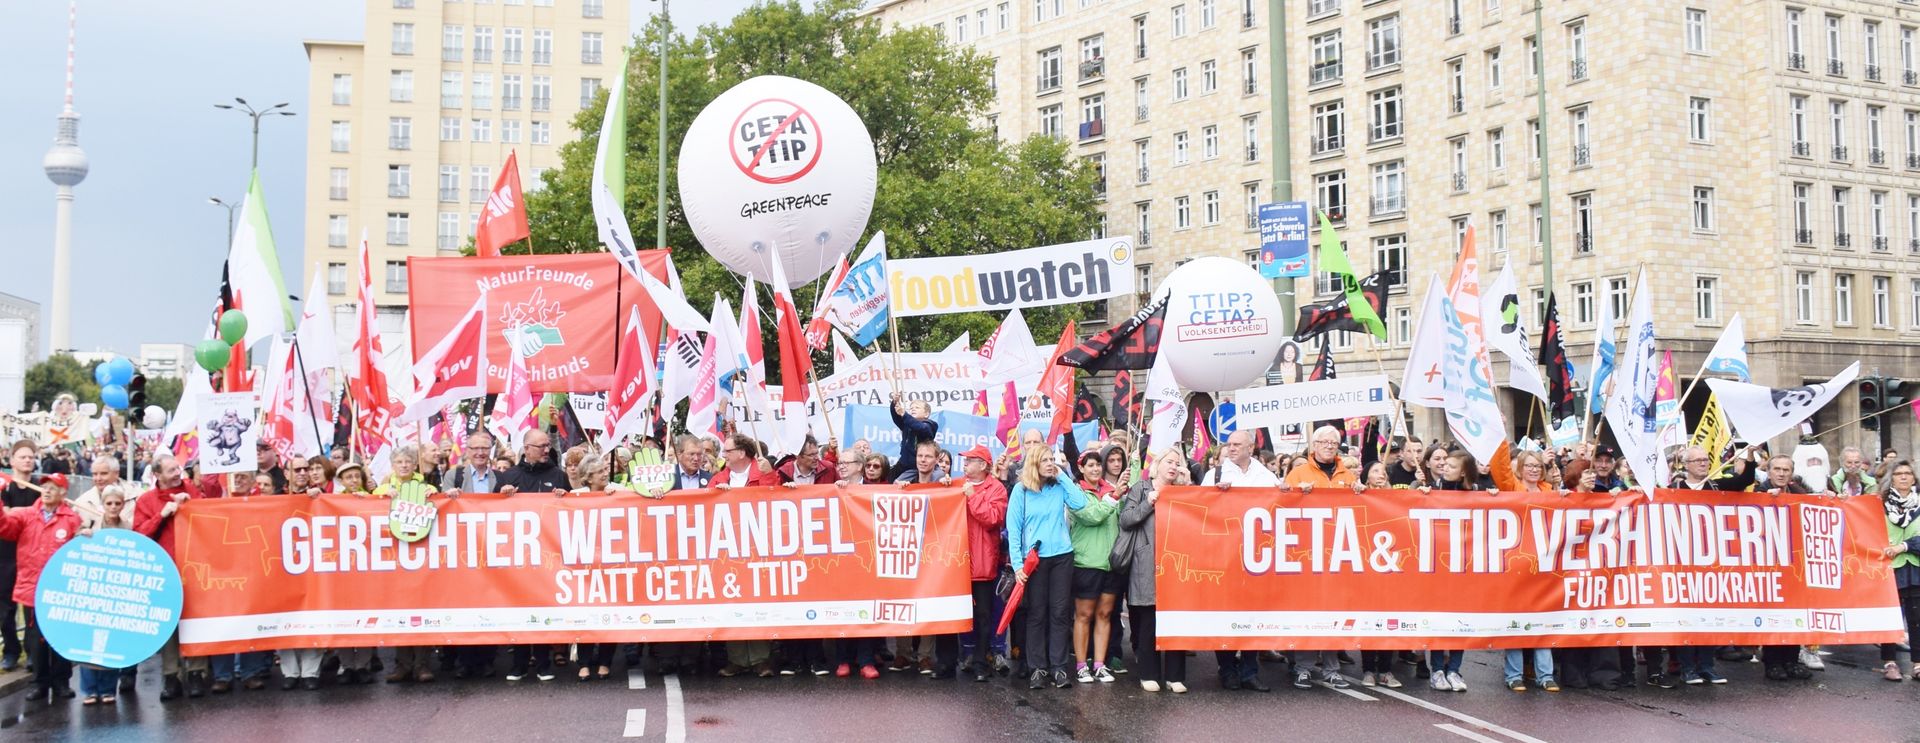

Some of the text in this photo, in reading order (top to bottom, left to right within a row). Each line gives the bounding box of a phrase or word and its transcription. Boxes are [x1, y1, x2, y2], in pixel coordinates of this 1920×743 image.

[740, 114, 807, 142] CETA
[748, 139, 807, 167] TTIP
[741, 193, 832, 218] GREENPEACE
[1273, 222, 1305, 232] Schwerin
[475, 265, 594, 293] NaturFreunde
[891, 252, 1111, 311] foodwatch
[1188, 292, 1253, 309] TTIP?
[1189, 309, 1254, 325] CETA?
[1185, 325, 1263, 336] VOLKSENTSCHEID!
[821, 388, 882, 413] CETA
[1241, 400, 1280, 415] MEHR
[1284, 391, 1363, 410] DEMOKRATIE
[1033, 411, 1051, 419] Welt
[637, 465, 672, 476] STOP
[398, 502, 433, 517] STOP
[876, 495, 923, 524] STOP
[1803, 506, 1839, 535] STOP
[558, 498, 855, 566] WELTHANDEL
[877, 523, 919, 549] CETA
[1243, 503, 1793, 575] CETA & TTIP VERHINDERN
[1805, 535, 1837, 560] CETA
[61, 562, 165, 591] HIER IST KEIN PLATZ
[878, 550, 917, 577] TTIP
[1807, 561, 1838, 586] TTIP
[67, 576, 151, 605] FÜR RASSISMUS,
[555, 561, 808, 605] STATT CETA & TTIP
[1563, 571, 1784, 608] FÜR DIE DEMOKRATIE
[42, 589, 172, 622] RECHTSPOPULISMUS UND
[877, 601, 914, 622] JETZT
[48, 606, 160, 636] ANTIAMERIKANISMUS
[1810, 611, 1843, 631] JETZT
